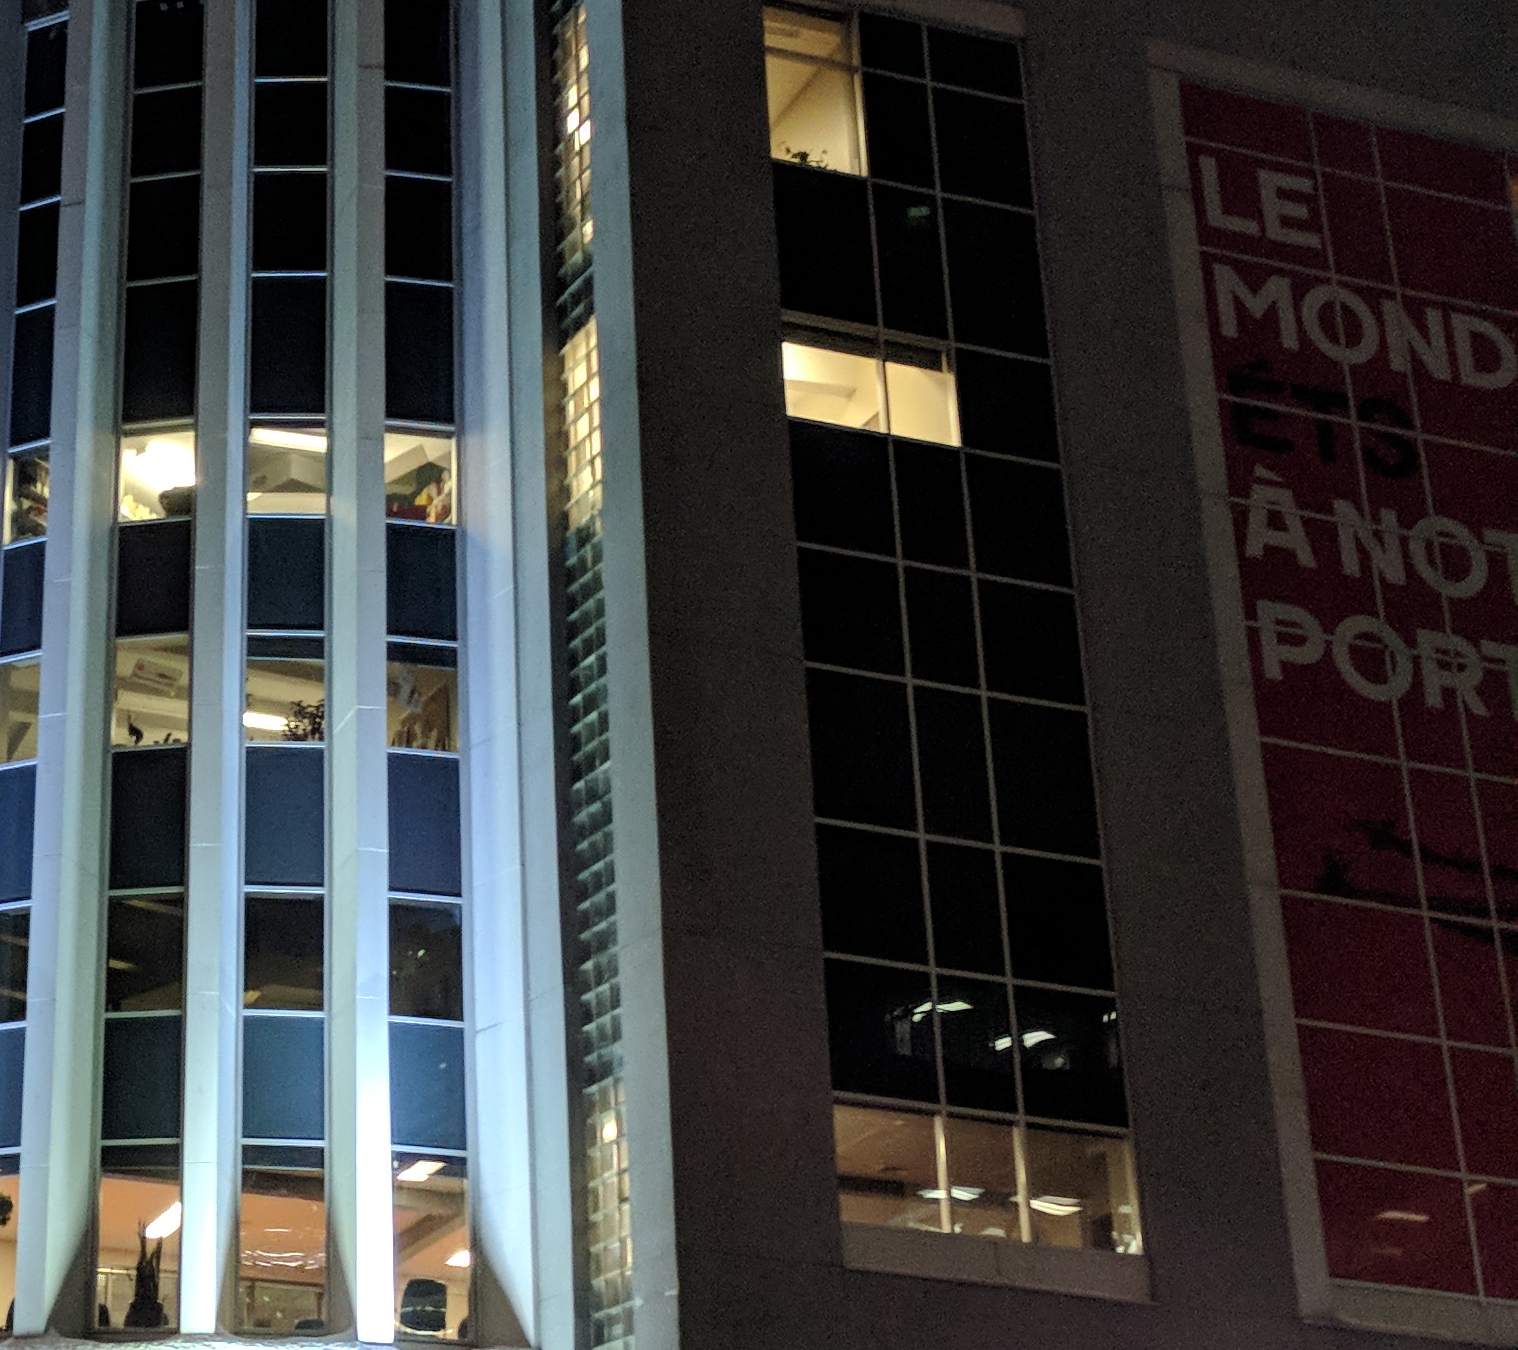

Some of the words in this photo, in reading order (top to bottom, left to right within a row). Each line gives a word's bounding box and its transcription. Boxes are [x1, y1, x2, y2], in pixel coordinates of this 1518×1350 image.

[1197, 154, 1324, 251] LE
[1212, 263, 1518, 392] MOND
[1244, 462, 1318, 570] À
